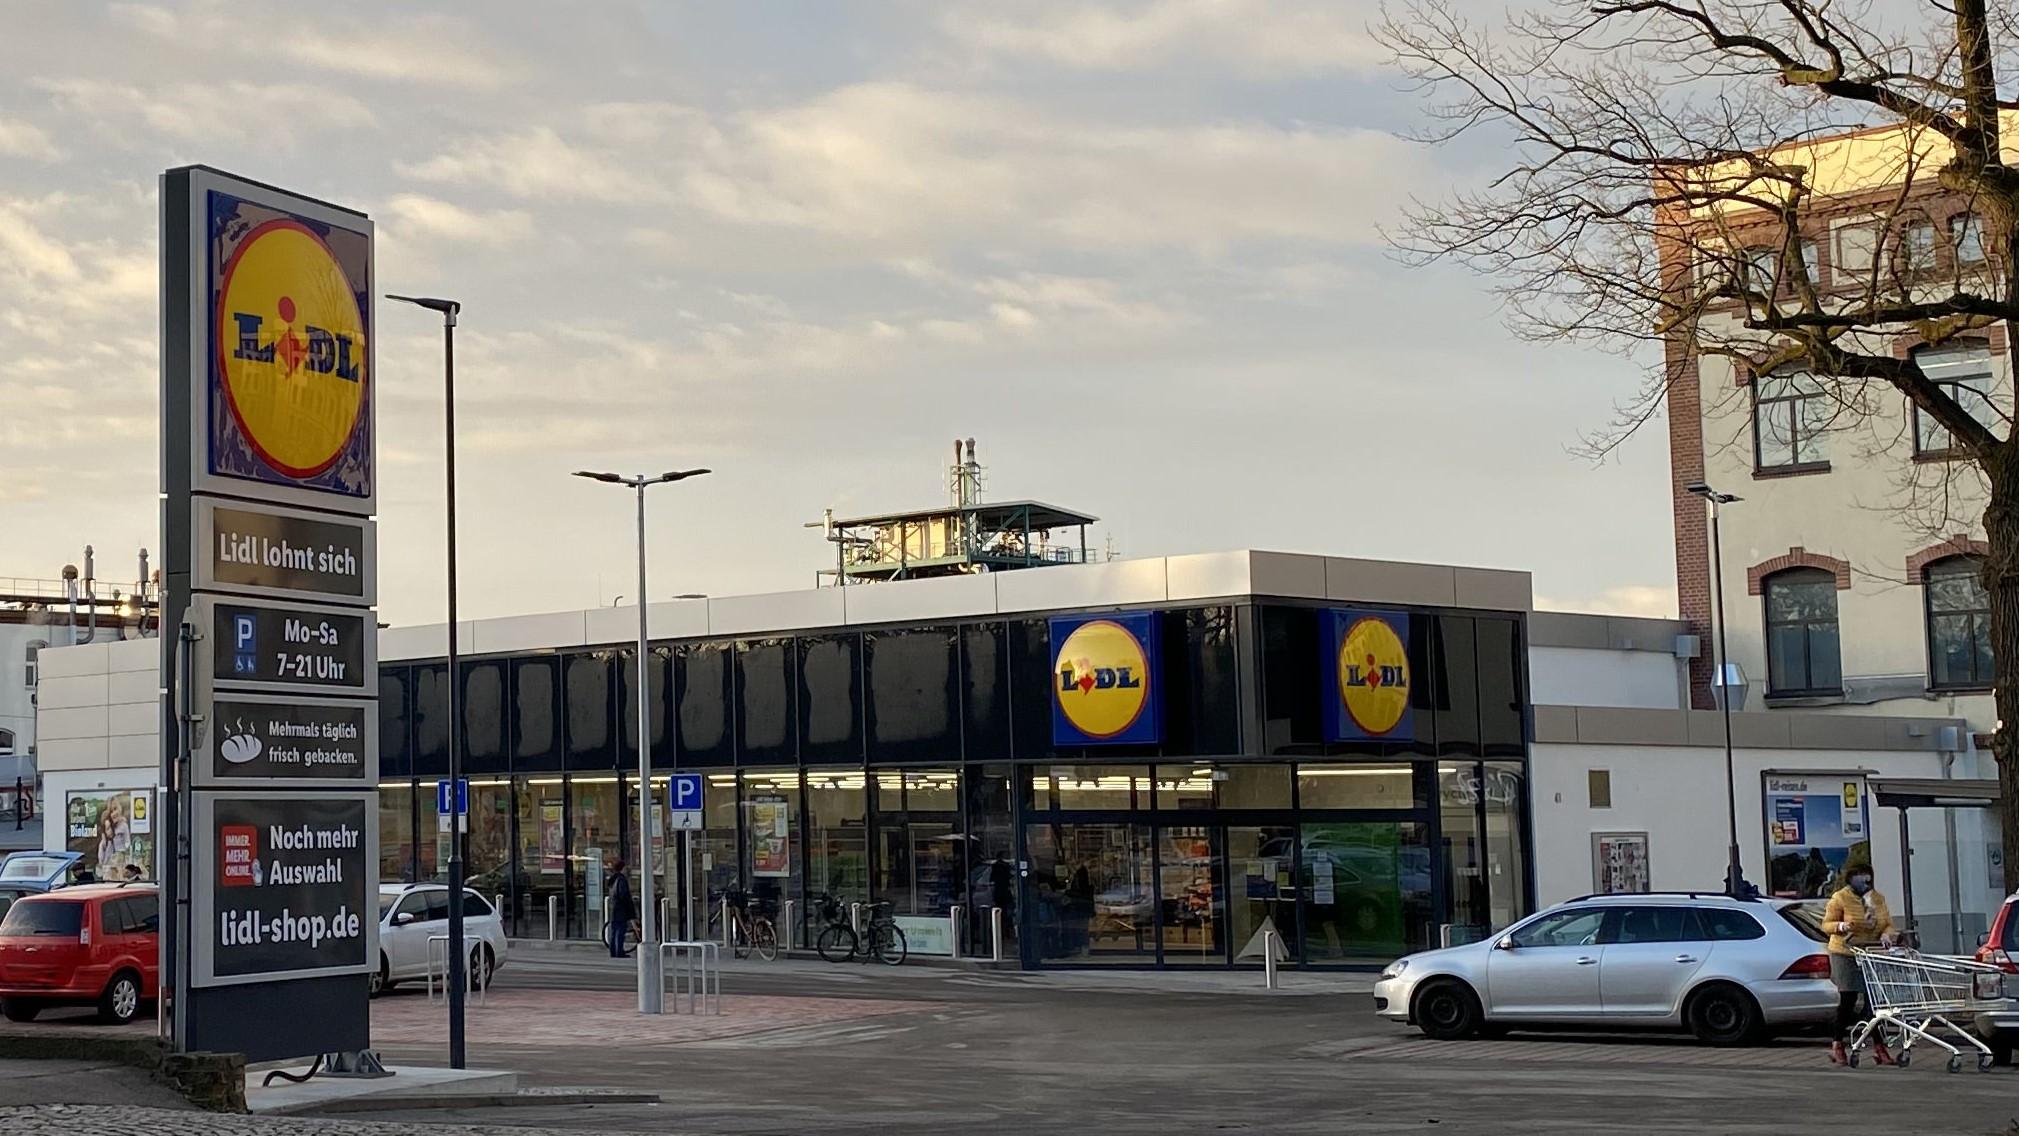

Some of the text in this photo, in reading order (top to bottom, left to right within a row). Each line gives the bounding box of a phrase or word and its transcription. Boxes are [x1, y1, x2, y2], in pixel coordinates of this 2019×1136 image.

[220, 532, 357, 577] Lidl lohnt sich
[237, 617, 253, 649] P
[315, 653, 346, 681] Uhr
[268, 720, 357, 742] Mehrmals täglich
[268, 745, 358, 767] frisch gebacken.
[677, 779, 695, 806] P
[270, 823, 359, 850] Noch mehr
[225, 849, 251, 863] MEHR.
[270, 858, 342, 885] Auswahl
[221, 906, 359, 948] lidl-shop.de
